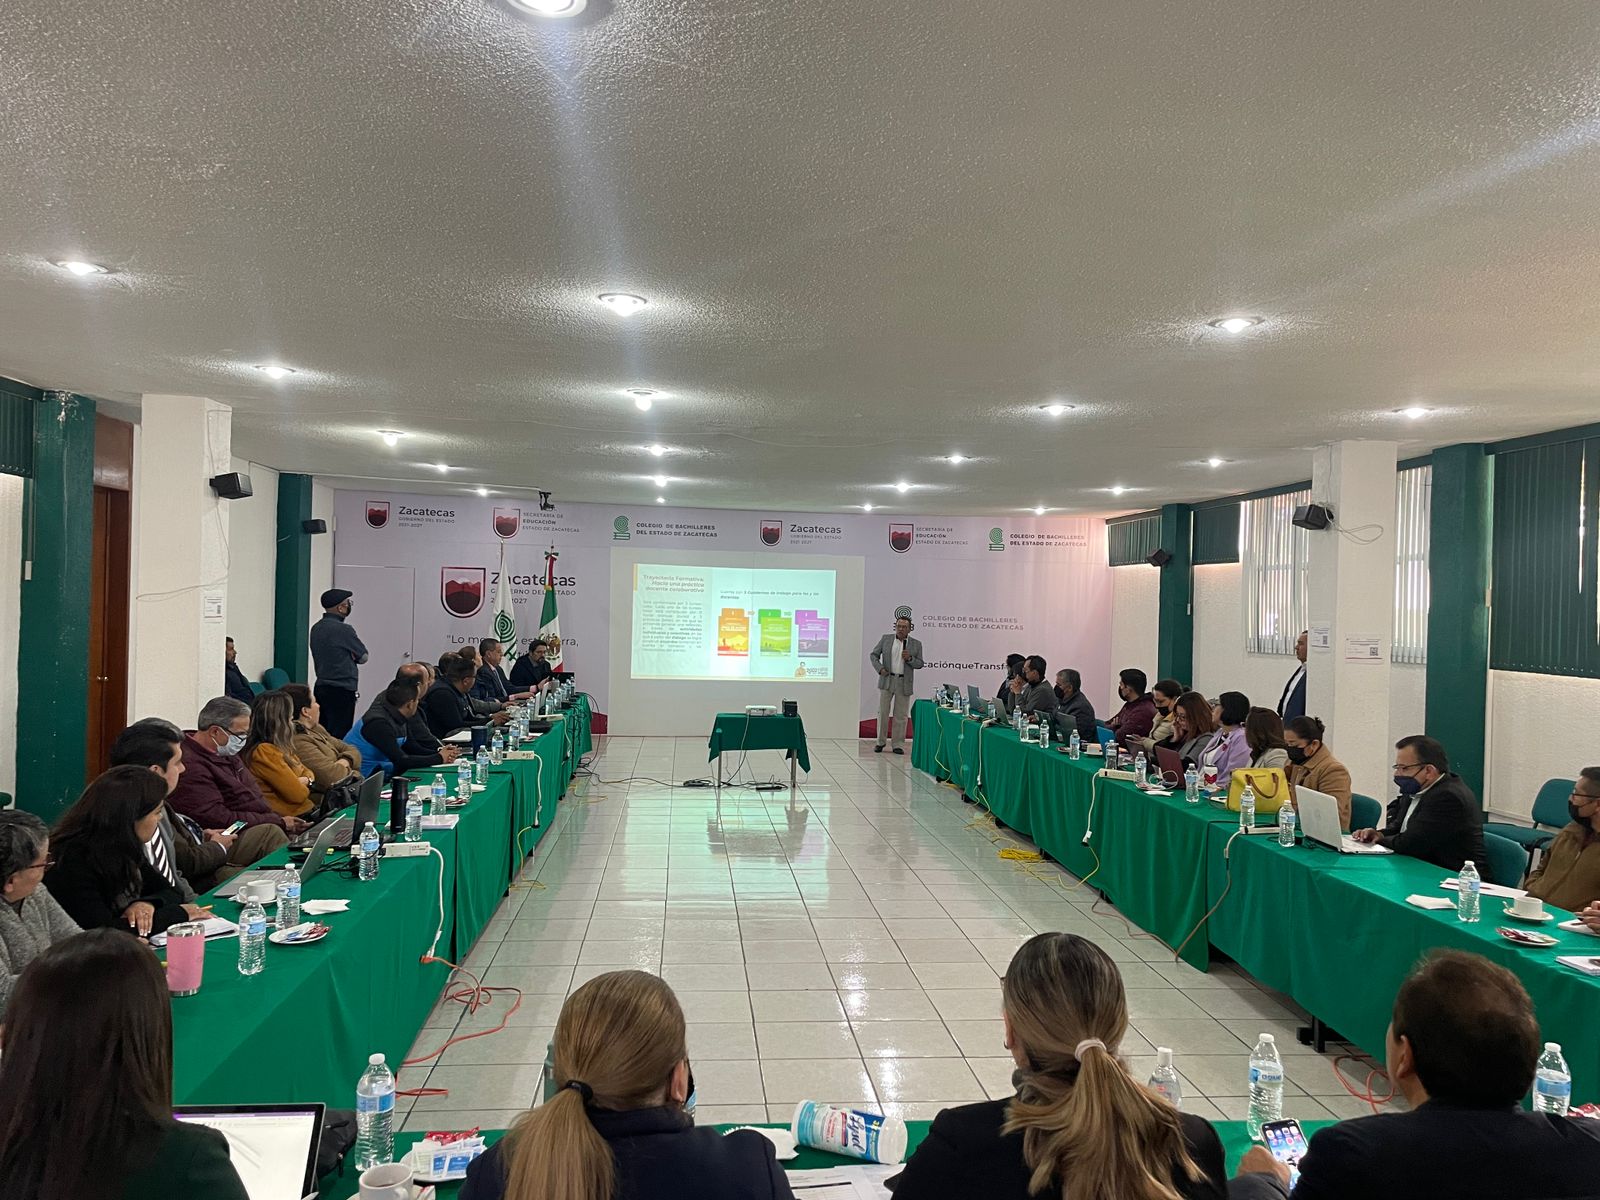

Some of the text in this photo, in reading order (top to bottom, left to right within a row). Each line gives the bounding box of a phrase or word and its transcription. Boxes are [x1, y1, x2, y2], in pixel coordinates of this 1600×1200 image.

[399, 506, 455, 517] Zacatecas
[790, 524, 842, 534] Zacatecas
[491, 572, 576, 586] Zcatecas
[847, 1115, 865, 1152] Lysol
